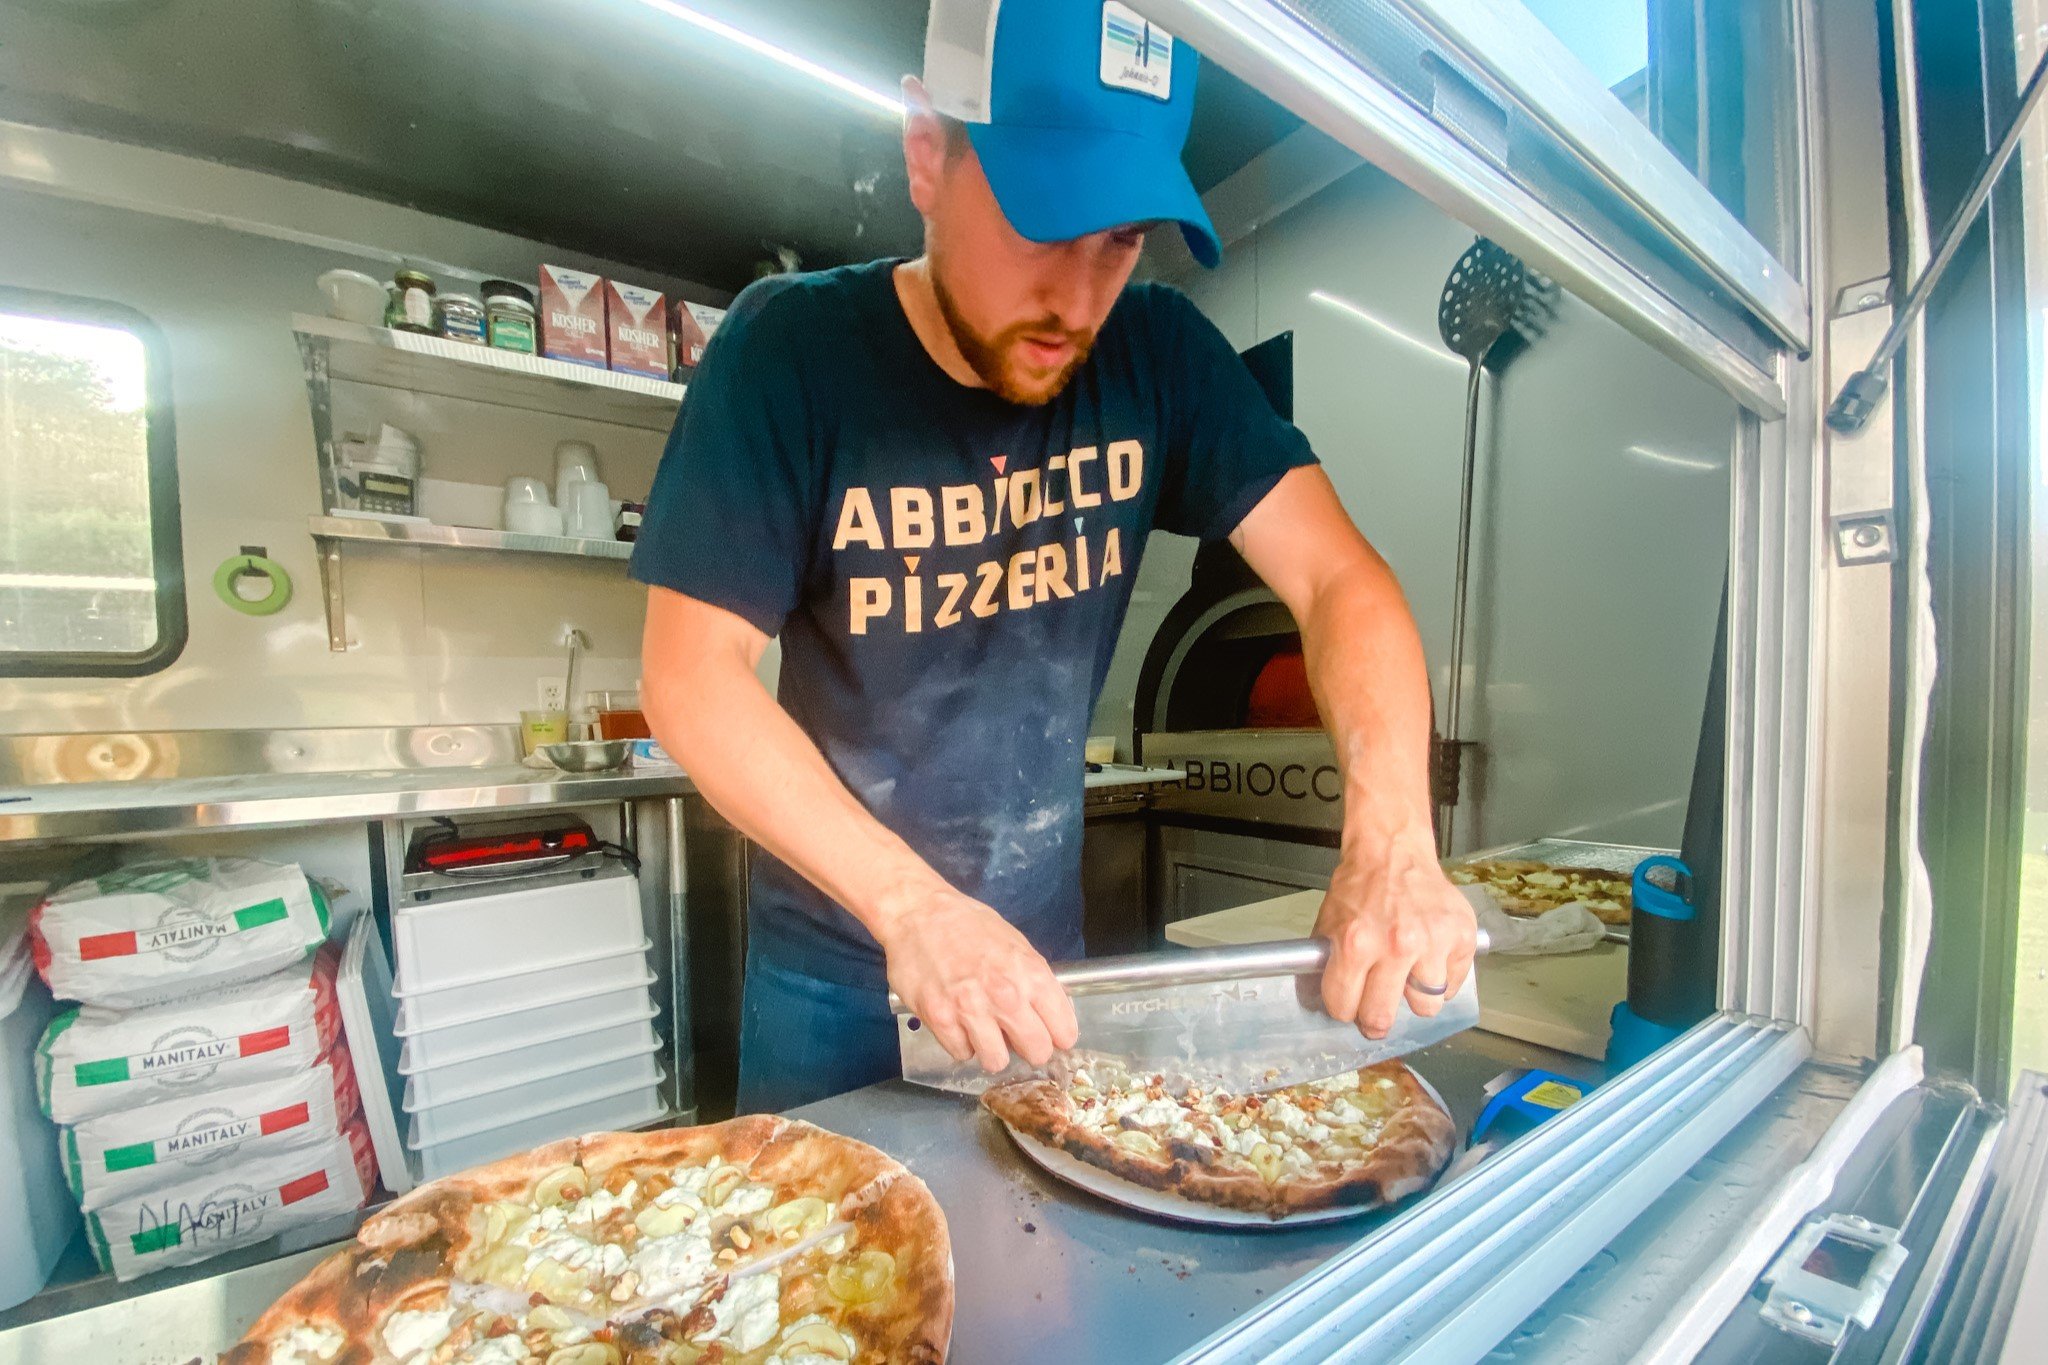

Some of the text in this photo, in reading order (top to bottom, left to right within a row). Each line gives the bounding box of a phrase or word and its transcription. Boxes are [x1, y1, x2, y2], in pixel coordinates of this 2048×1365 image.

[552, 311, 597, 335] KOSHER
[618, 325, 660, 348] KOSHER
[832, 439, 1143, 550] ABBIOCCO
[849, 518, 1122, 634] PIZZERIA
[1160, 759, 1341, 803] ABBIOCC
[151, 924, 227, 947] MANITALY
[143, 1043, 225, 1069] MANITALY
[168, 1122, 247, 1152] MANITALY
